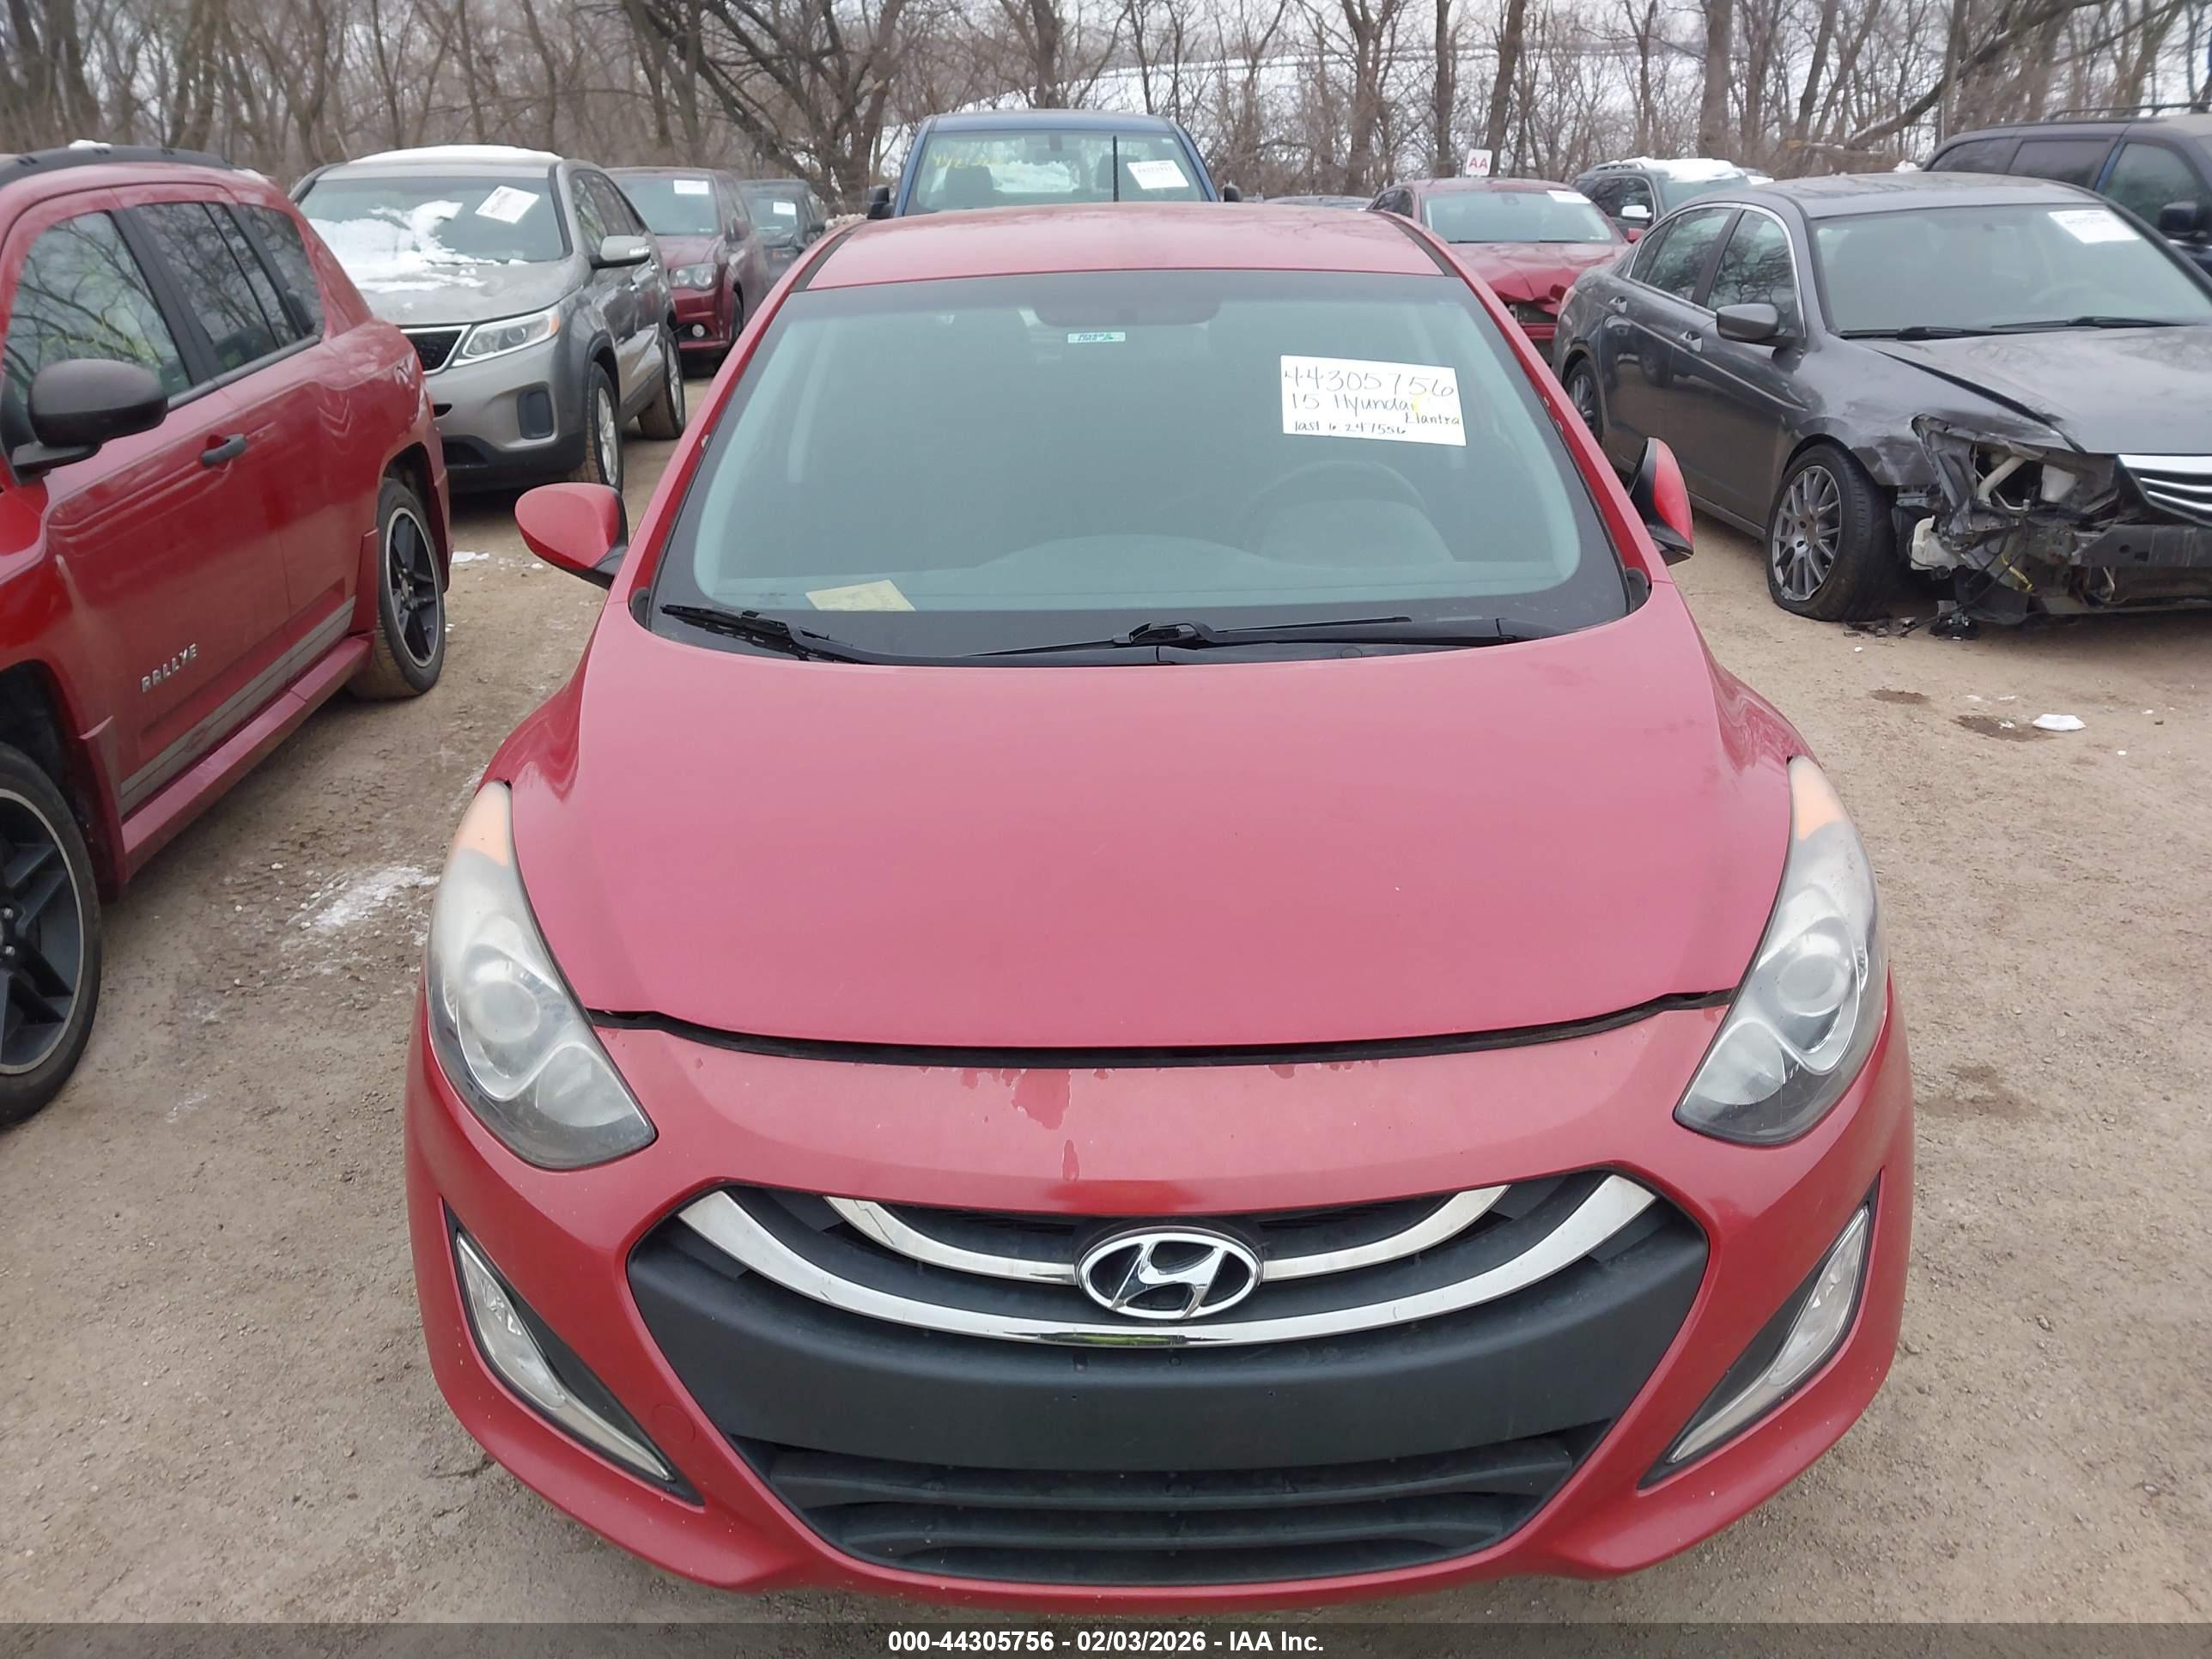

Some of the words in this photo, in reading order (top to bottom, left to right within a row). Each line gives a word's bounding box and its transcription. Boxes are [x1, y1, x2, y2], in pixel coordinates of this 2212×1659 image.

[1469, 157, 1488, 169] AA
[1285, 366, 1455, 397] 44305756
[1292, 393, 1320, 410] 15
[1334, 394, 1415, 417] Hyundai
[1295, 421, 1320, 432] last
[1405, 412, 1461, 425] Elantra
[141, 642, 198, 694] RALLYE
